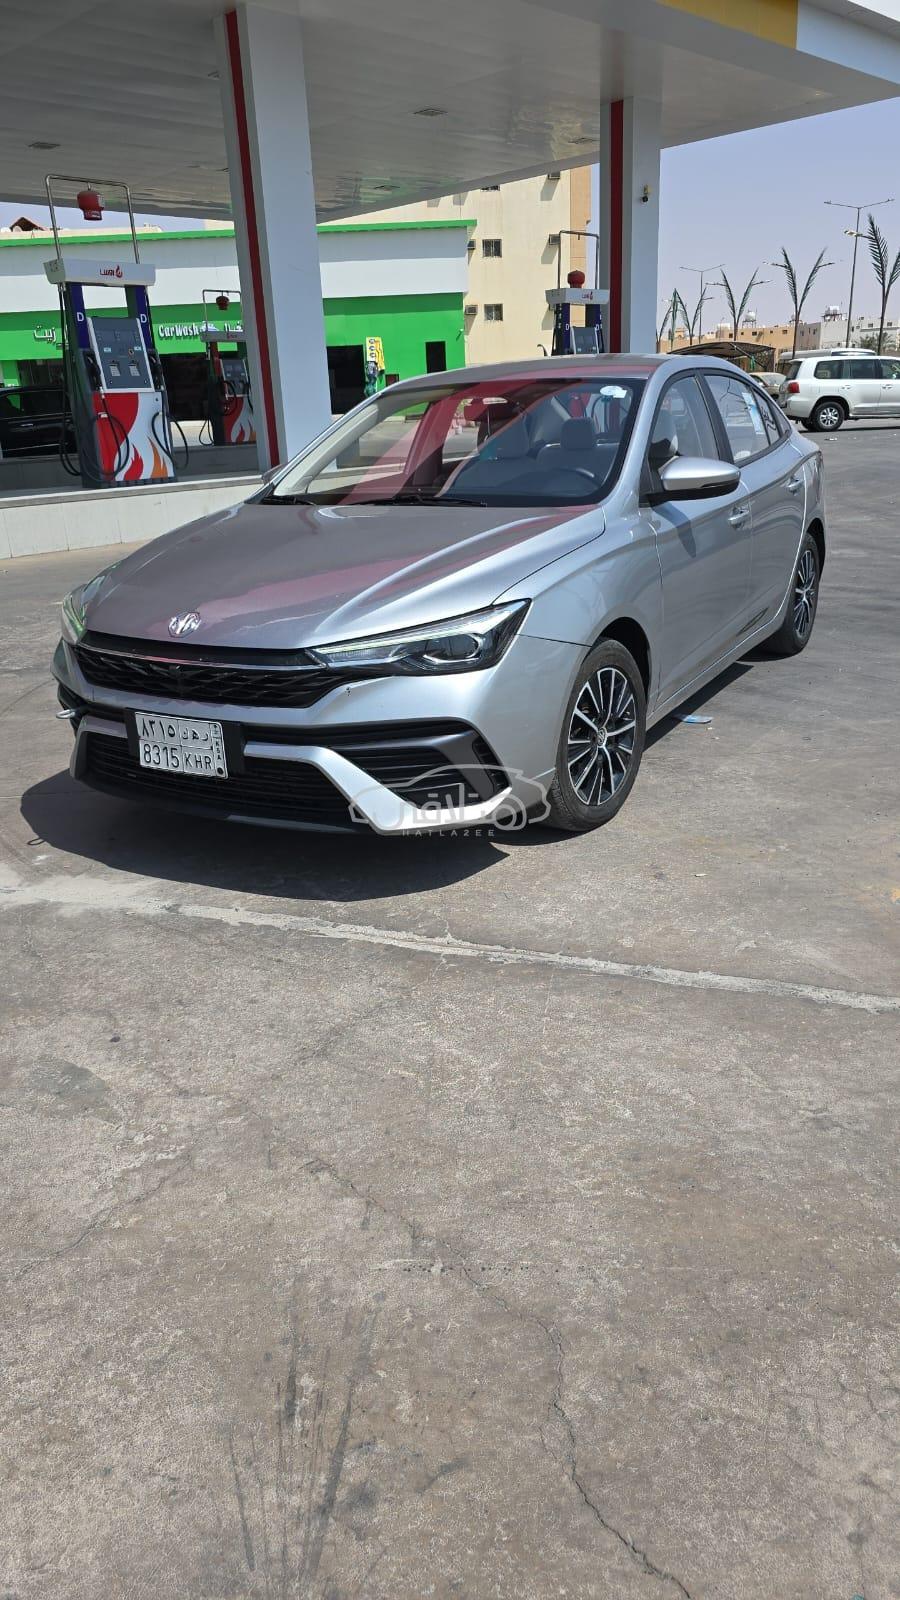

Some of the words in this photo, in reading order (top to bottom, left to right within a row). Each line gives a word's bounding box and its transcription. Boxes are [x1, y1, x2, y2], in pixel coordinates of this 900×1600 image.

[76, 311, 85, 322] D
[140, 313, 148, 323] D
[143, 743, 180, 768] 8315
[184, 752, 212, 769] KHR
